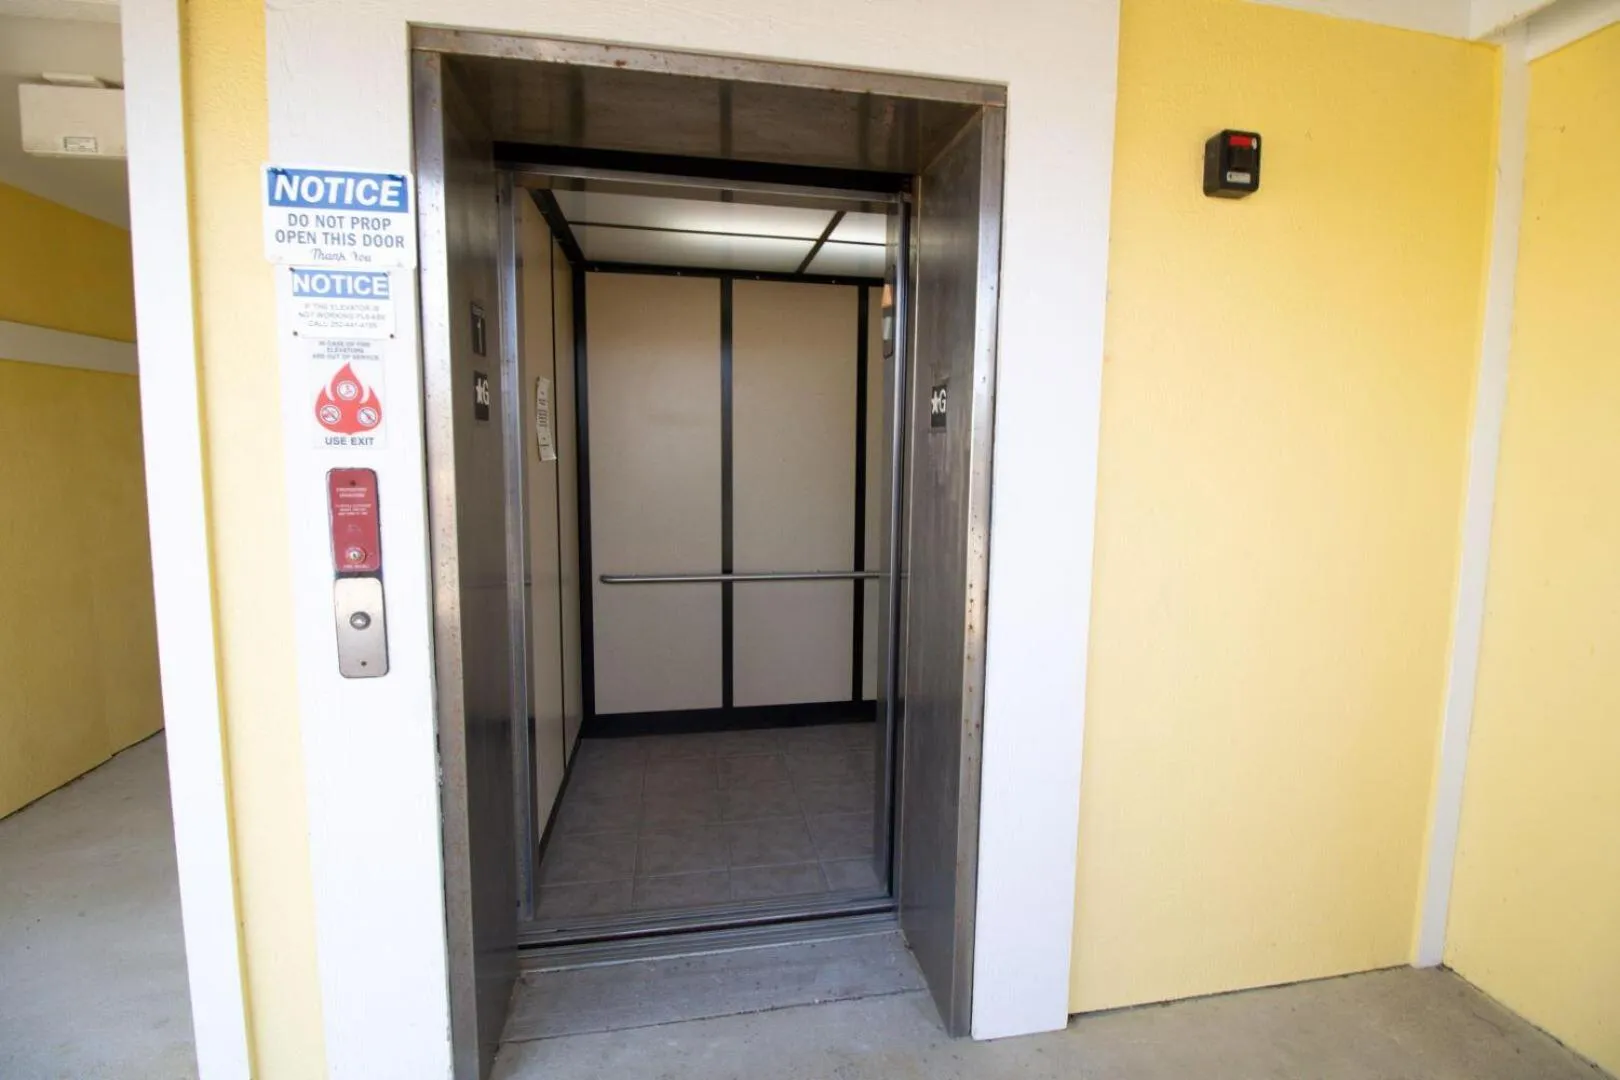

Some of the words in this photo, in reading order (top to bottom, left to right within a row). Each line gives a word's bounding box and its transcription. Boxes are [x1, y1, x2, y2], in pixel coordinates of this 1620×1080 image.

[274, 174, 403, 207] NOTICE
[288, 213, 309, 227] DO
[316, 214, 345, 229] NOT
[351, 216, 391, 231] PROP
[275, 229, 316, 245] OPEN
[322, 231, 357, 247] THIS
[363, 233, 405, 249] DOOR
[311, 248, 346, 262] Thank
[293, 273, 389, 296] NOTICE
[325, 436, 347, 446] USE
[350, 437, 375, 446] EXIT
